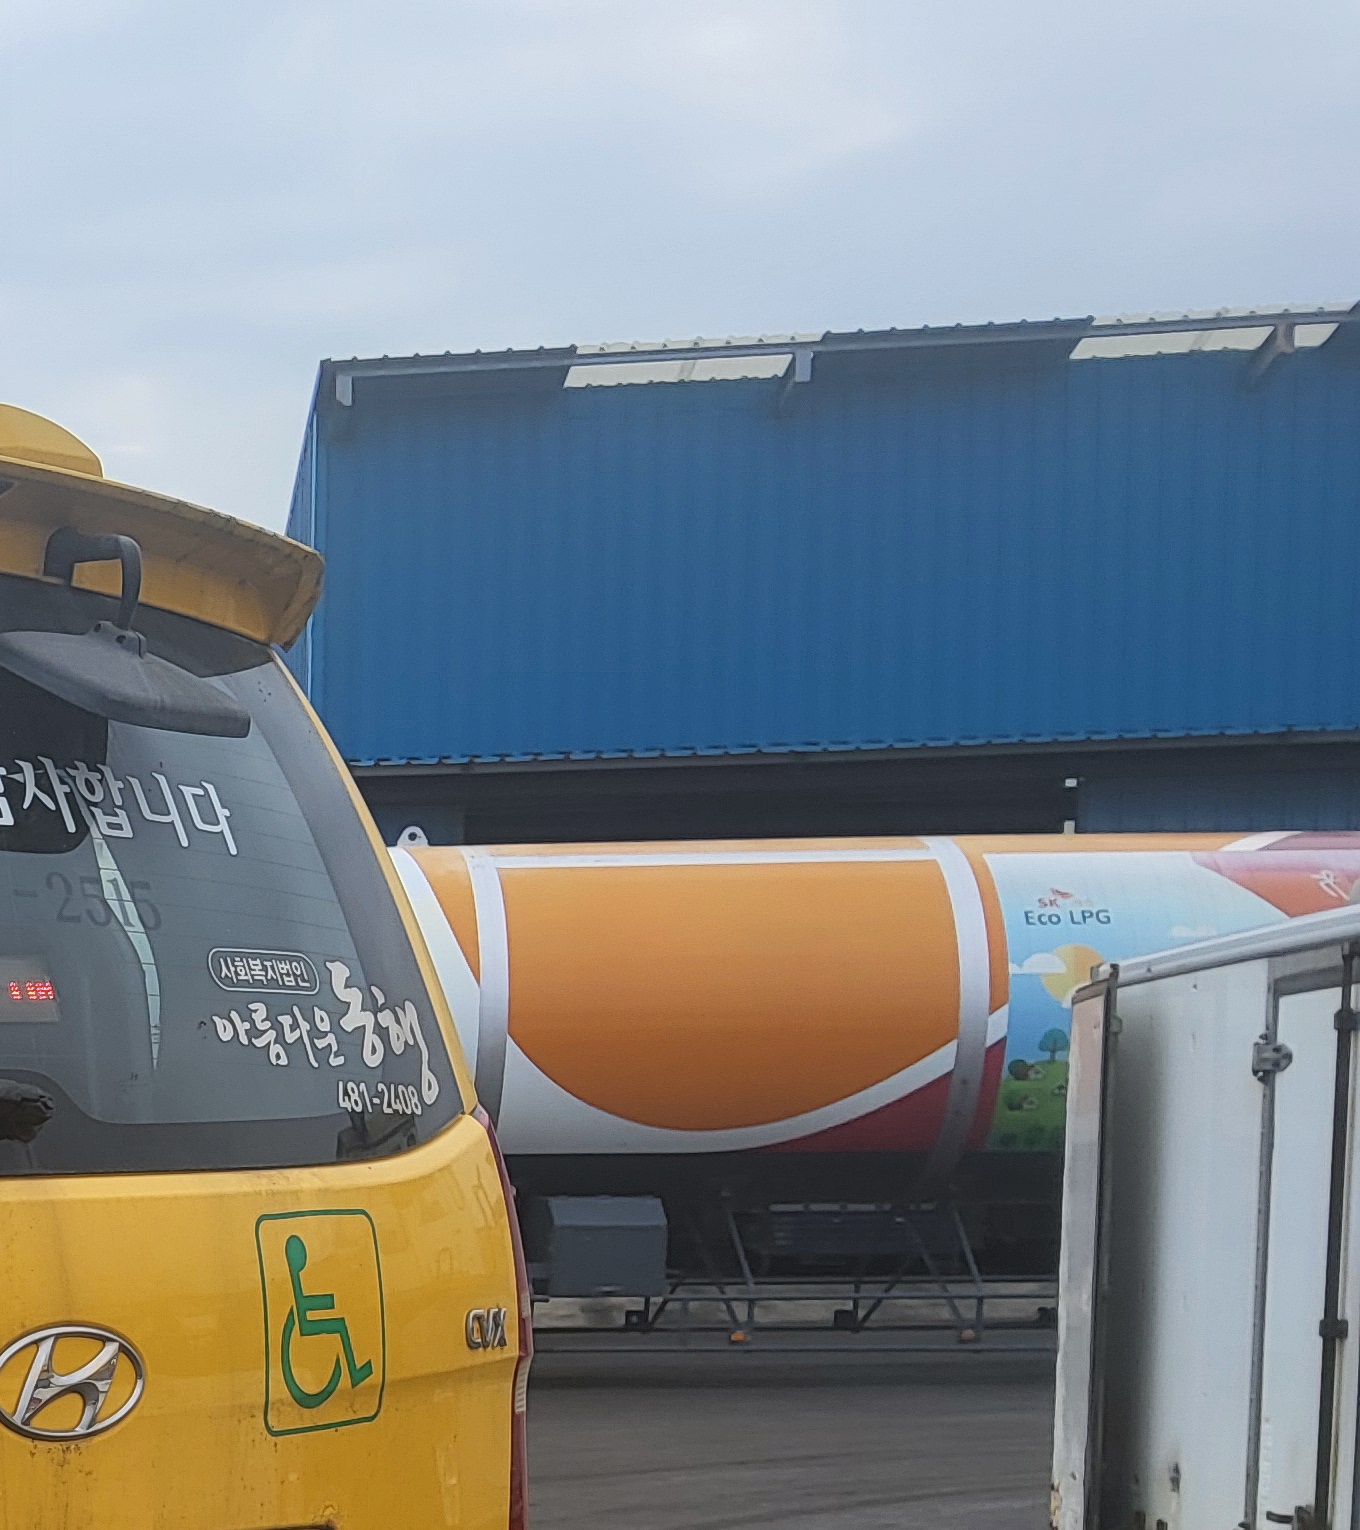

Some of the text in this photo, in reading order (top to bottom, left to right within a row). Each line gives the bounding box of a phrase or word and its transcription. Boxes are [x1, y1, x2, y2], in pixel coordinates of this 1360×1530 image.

[1023, 909, 1112, 926] Eco LPG
[218, 956, 311, 988] 사회복지법인
[212, 961, 439, 1106] 아름다운 동행
[338, 1080, 422, 1115] 481-2408
[465, 1307, 507, 1350] CVX
